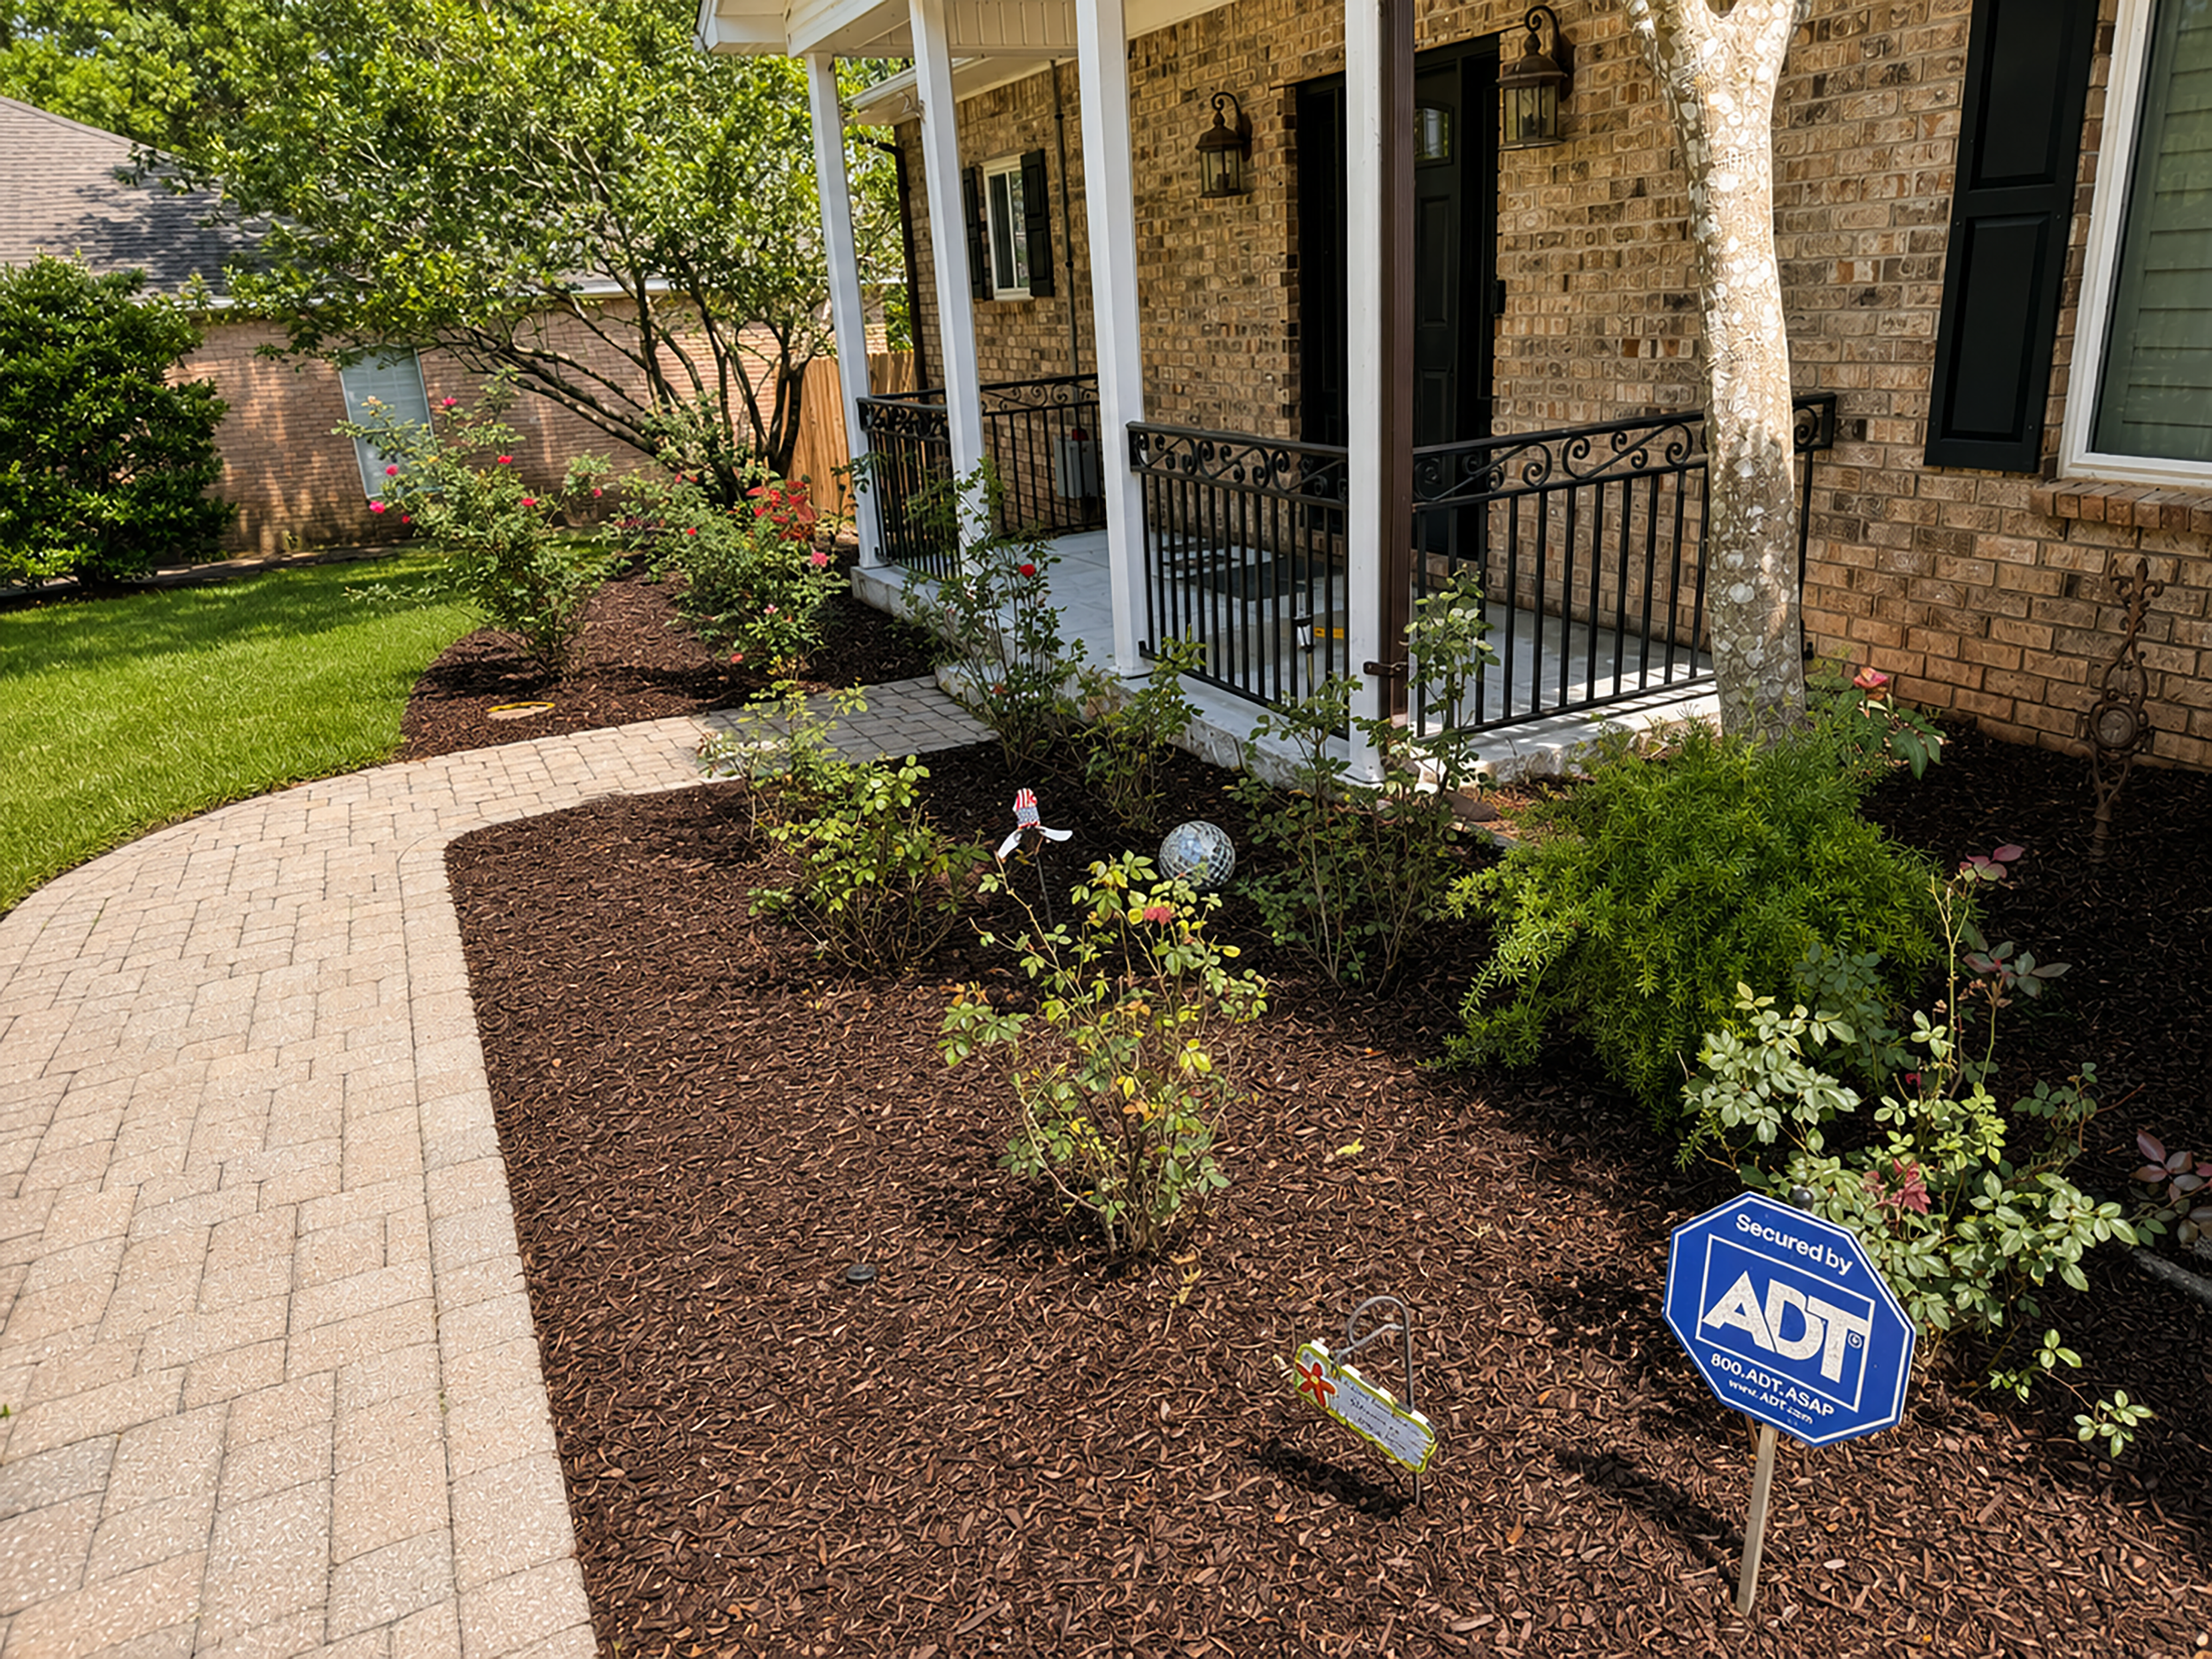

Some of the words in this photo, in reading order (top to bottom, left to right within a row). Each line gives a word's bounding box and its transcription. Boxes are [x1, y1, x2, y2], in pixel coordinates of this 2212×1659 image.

[1735, 1213, 1824, 1263] Secured
[1825, 1247, 1853, 1276] by
[1701, 1271, 1868, 1383] ADT
[1711, 1353, 1834, 1416] 800.ADT.ASAP
